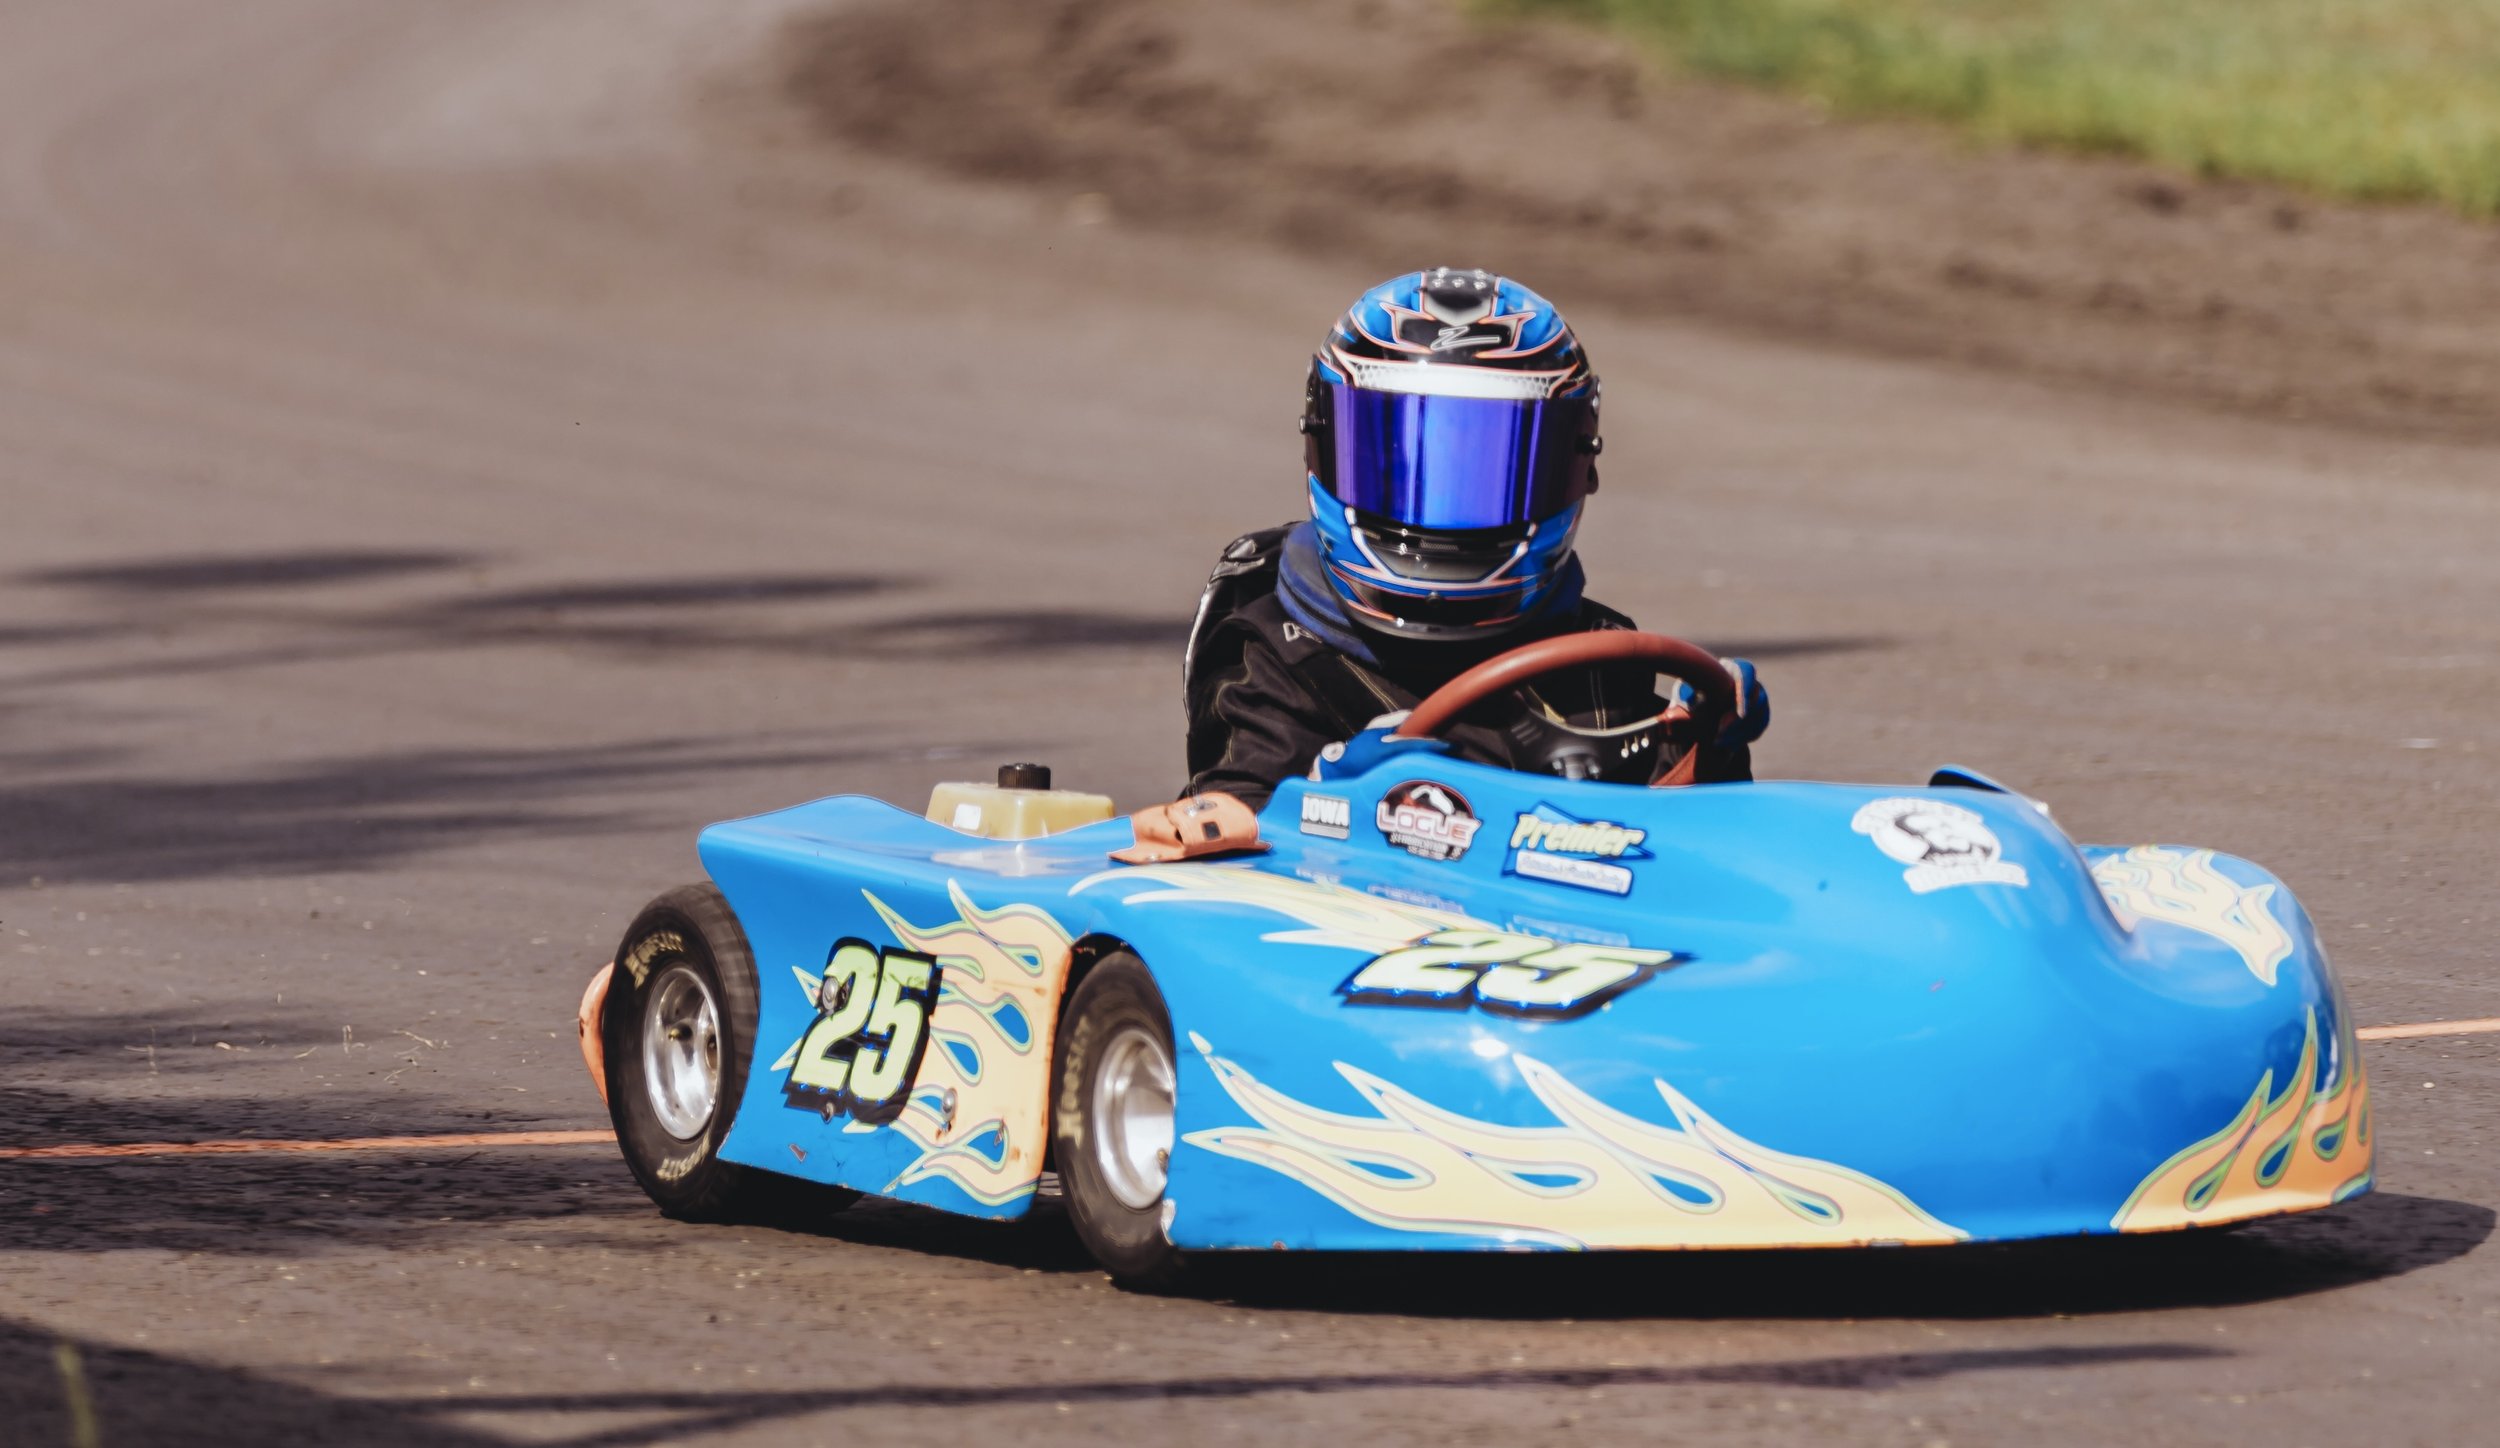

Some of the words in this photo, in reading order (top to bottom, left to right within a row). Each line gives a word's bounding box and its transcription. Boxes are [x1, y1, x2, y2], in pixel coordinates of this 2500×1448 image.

[1302, 796, 1350, 827] IOWA
[1377, 801, 1474, 849] LOGUE
[1511, 814, 1646, 856] Premier
[1344, 927, 1682, 1010] 25
[787, 940, 938, 1107] 25
